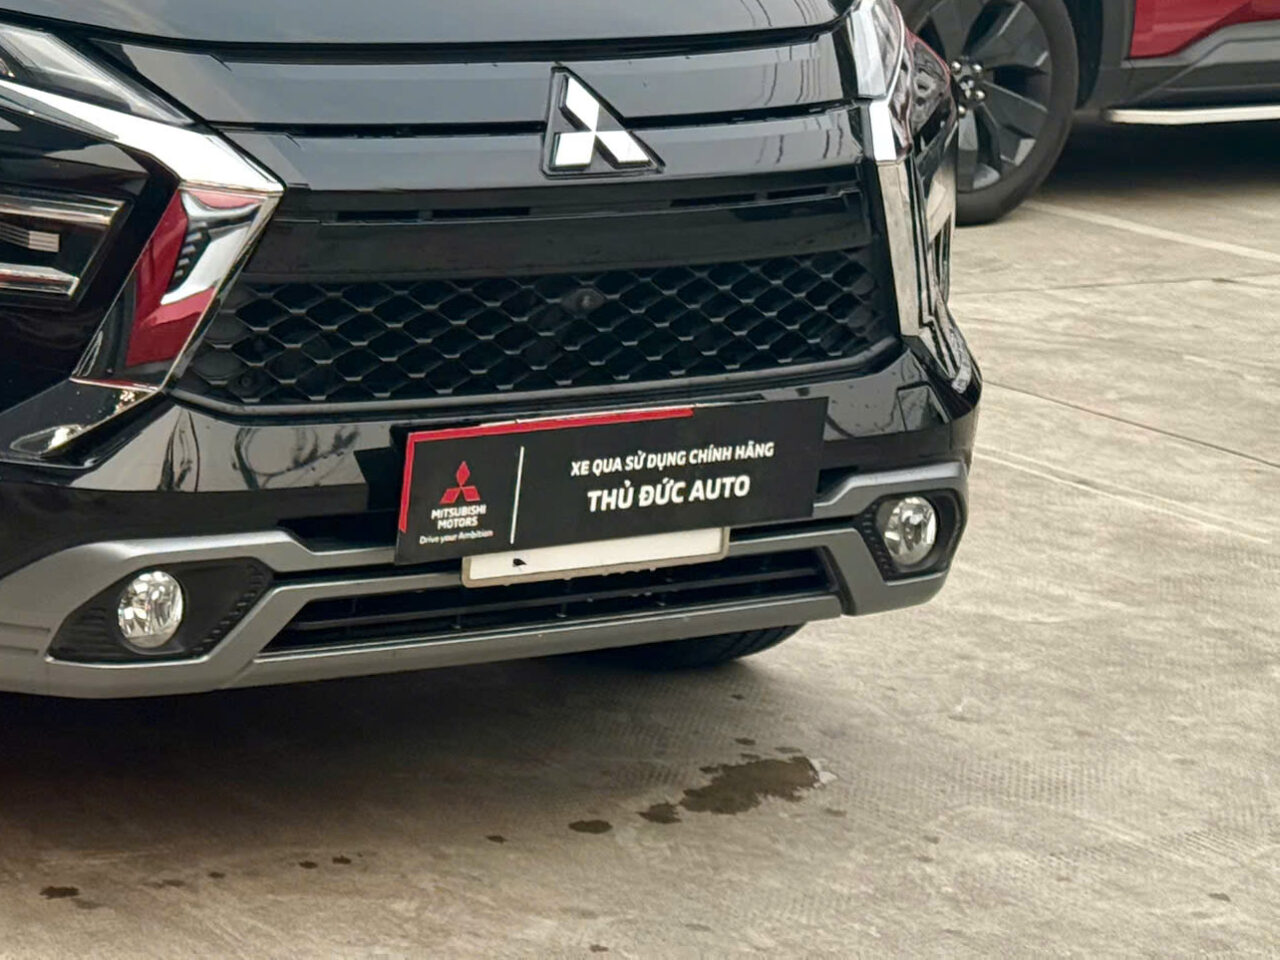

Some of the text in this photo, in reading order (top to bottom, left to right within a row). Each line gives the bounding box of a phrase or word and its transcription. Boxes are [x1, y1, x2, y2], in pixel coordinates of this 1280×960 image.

[571, 440, 775, 477] XE QUA SỬ DỤNG CHÍNH HÃNG
[587, 475, 750, 512] THỦ ĐỨC AUTO
[431, 504, 487, 520] MITSUBISHI
[437, 515, 478, 530] MOTORS
[419, 533, 440, 545] Drive
[458, 529, 494, 542] Ambition
